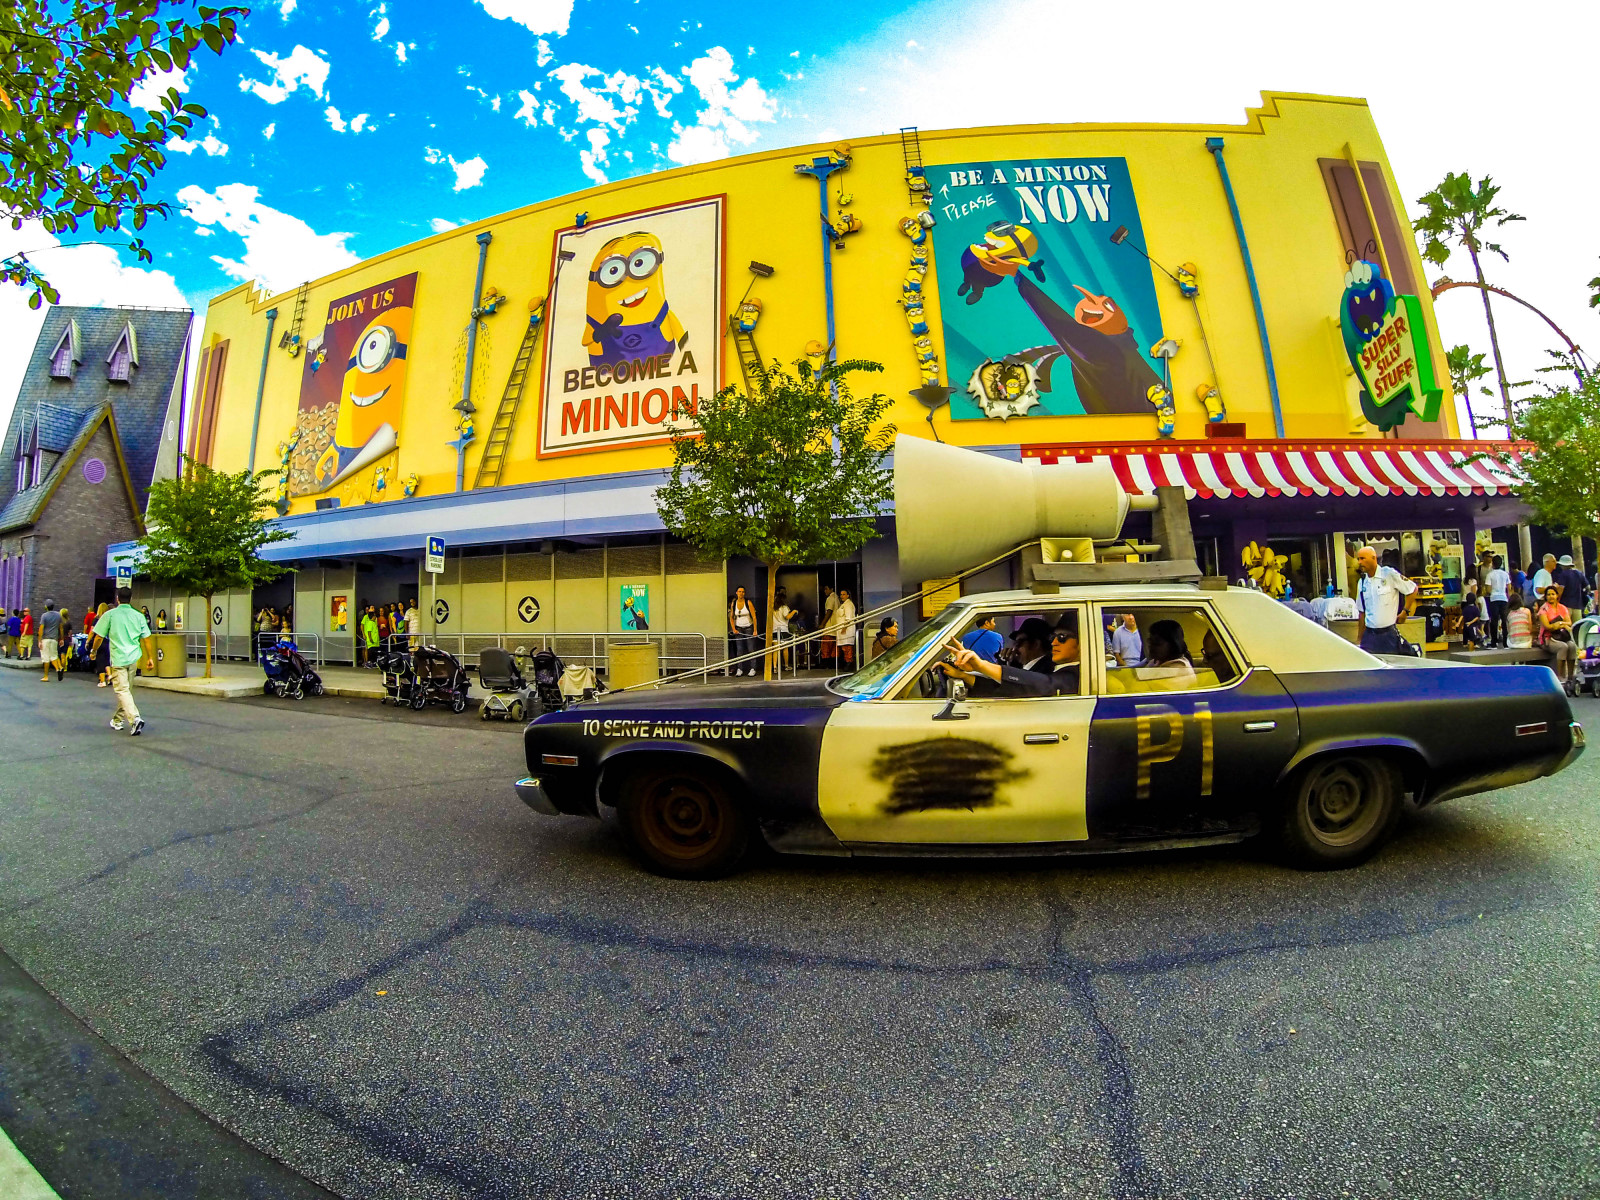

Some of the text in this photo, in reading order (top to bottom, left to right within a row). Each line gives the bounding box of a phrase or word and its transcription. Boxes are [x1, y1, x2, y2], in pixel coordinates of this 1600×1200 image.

[949, 165, 1108, 187] BE A MINION
[941, 192, 997, 222] PLEASE
[1014, 184, 1112, 224] NOW
[327, 287, 395, 325] JOIN US
[1362, 316, 1408, 370] SUPER
[1376, 343, 1401, 376] SILLY
[563, 350, 699, 394] BECOME A
[1374, 357, 1413, 399] STUFF
[561, 383, 699, 437] MINION
[582, 719, 765, 739] TO SERVE AND PROTECT
